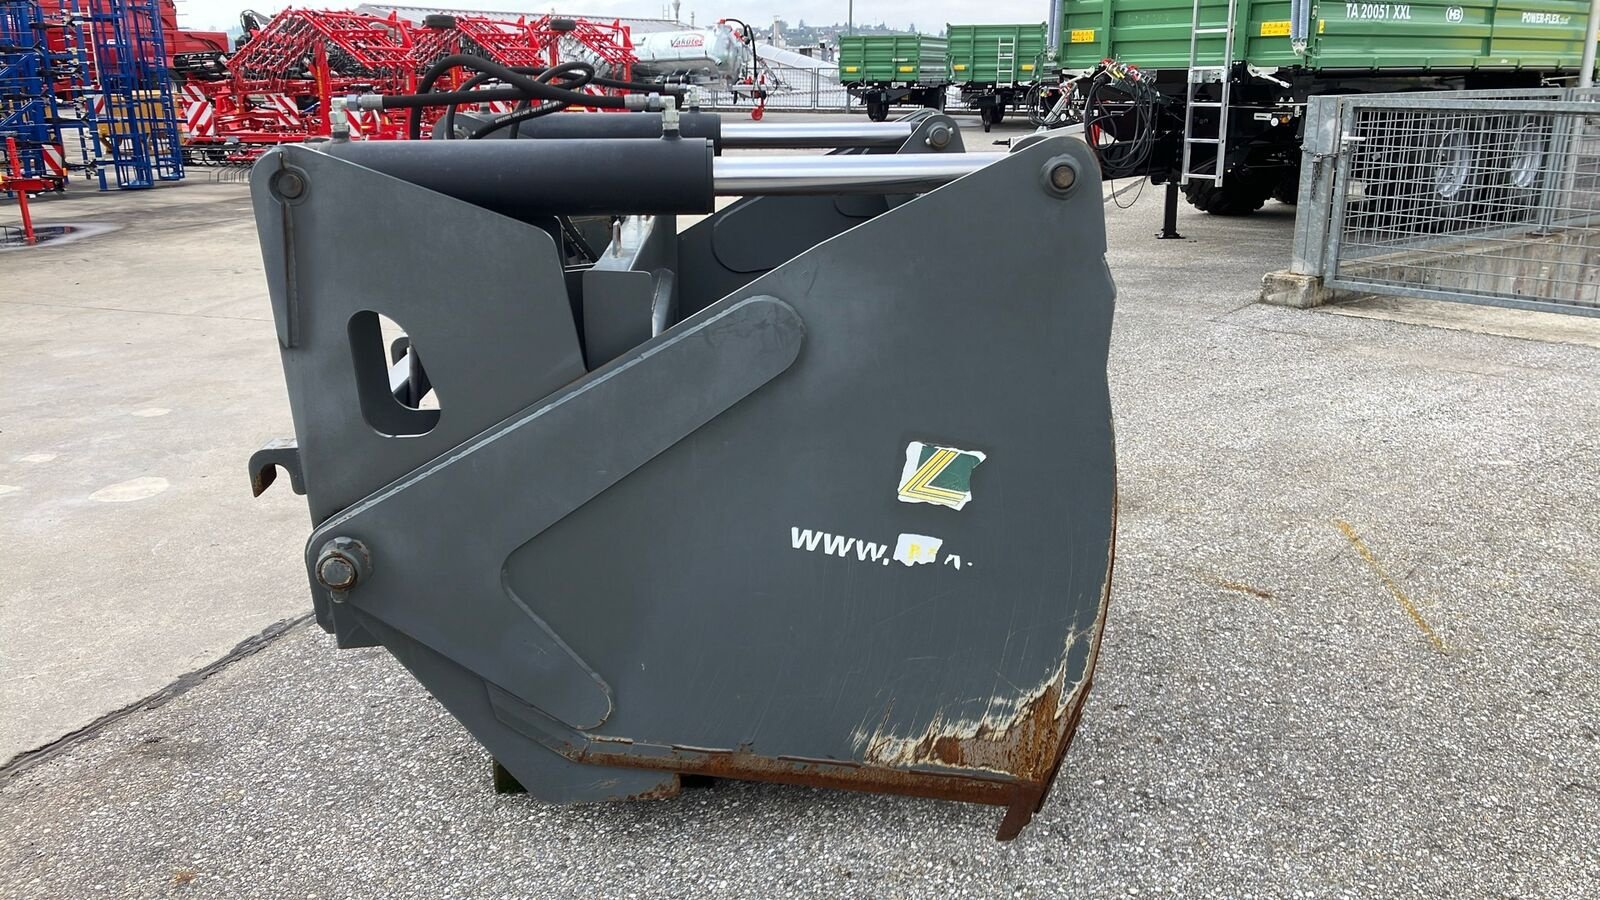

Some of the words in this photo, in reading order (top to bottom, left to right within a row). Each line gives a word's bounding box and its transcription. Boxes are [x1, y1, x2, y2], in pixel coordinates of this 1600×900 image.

[1346, 3, 1358, 18] TA
[1361, 4, 1389, 19] 20051
[1393, 5, 1412, 20] XXL
